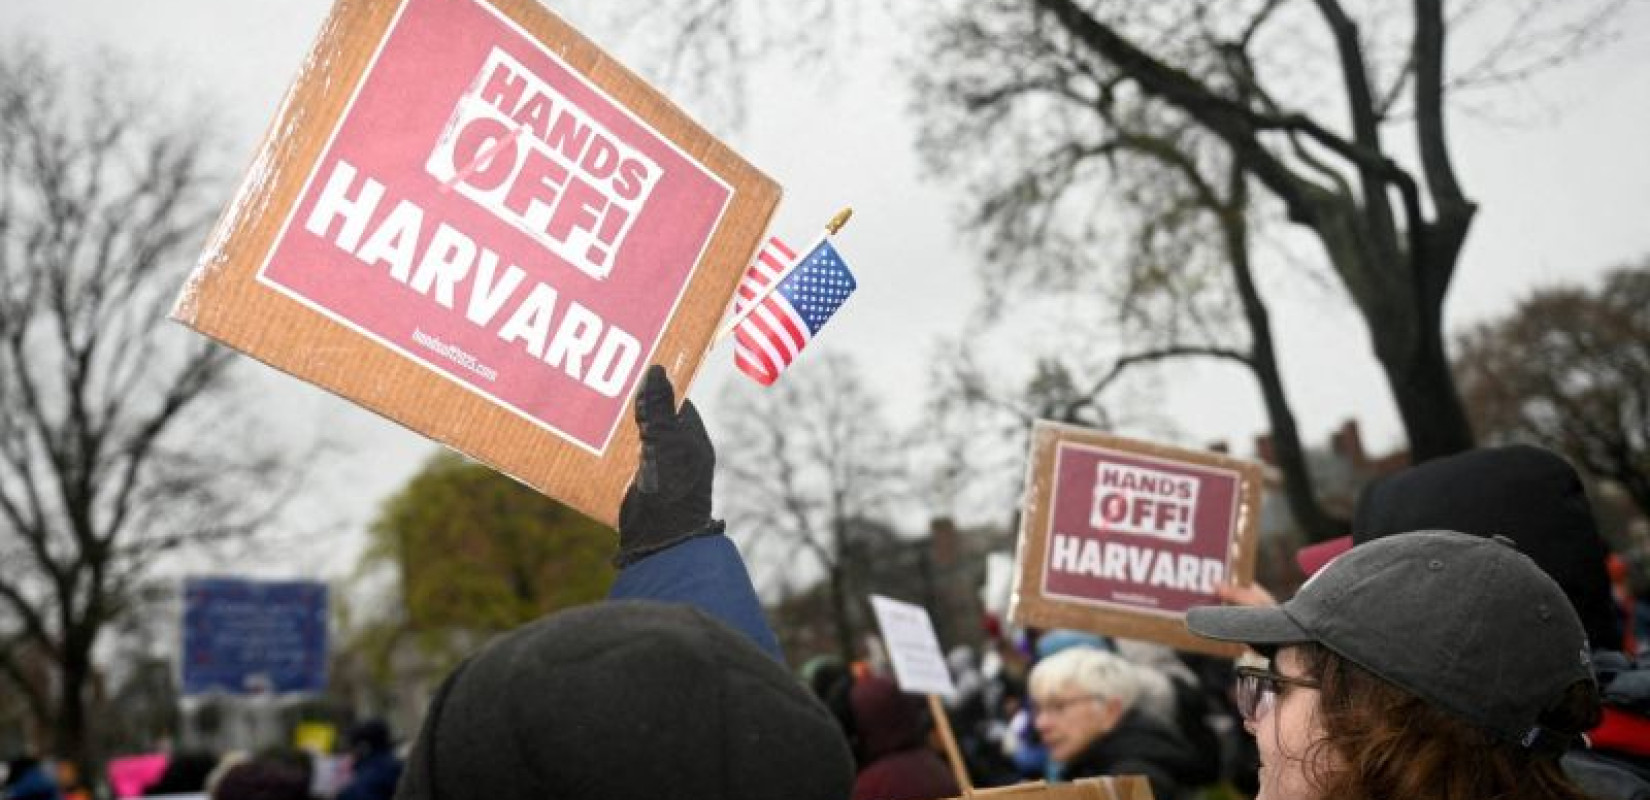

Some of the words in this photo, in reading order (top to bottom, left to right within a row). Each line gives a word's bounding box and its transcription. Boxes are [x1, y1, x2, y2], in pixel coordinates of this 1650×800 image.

[480, 62, 648, 203] HANDS
[453, 116, 632, 269] OFF!
[305, 160, 643, 399] HARVARD
[1100, 493, 1190, 535] OFF!
[1102, 469, 1192, 498] HANDS
[1052, 534, 1224, 594] HARVARD
